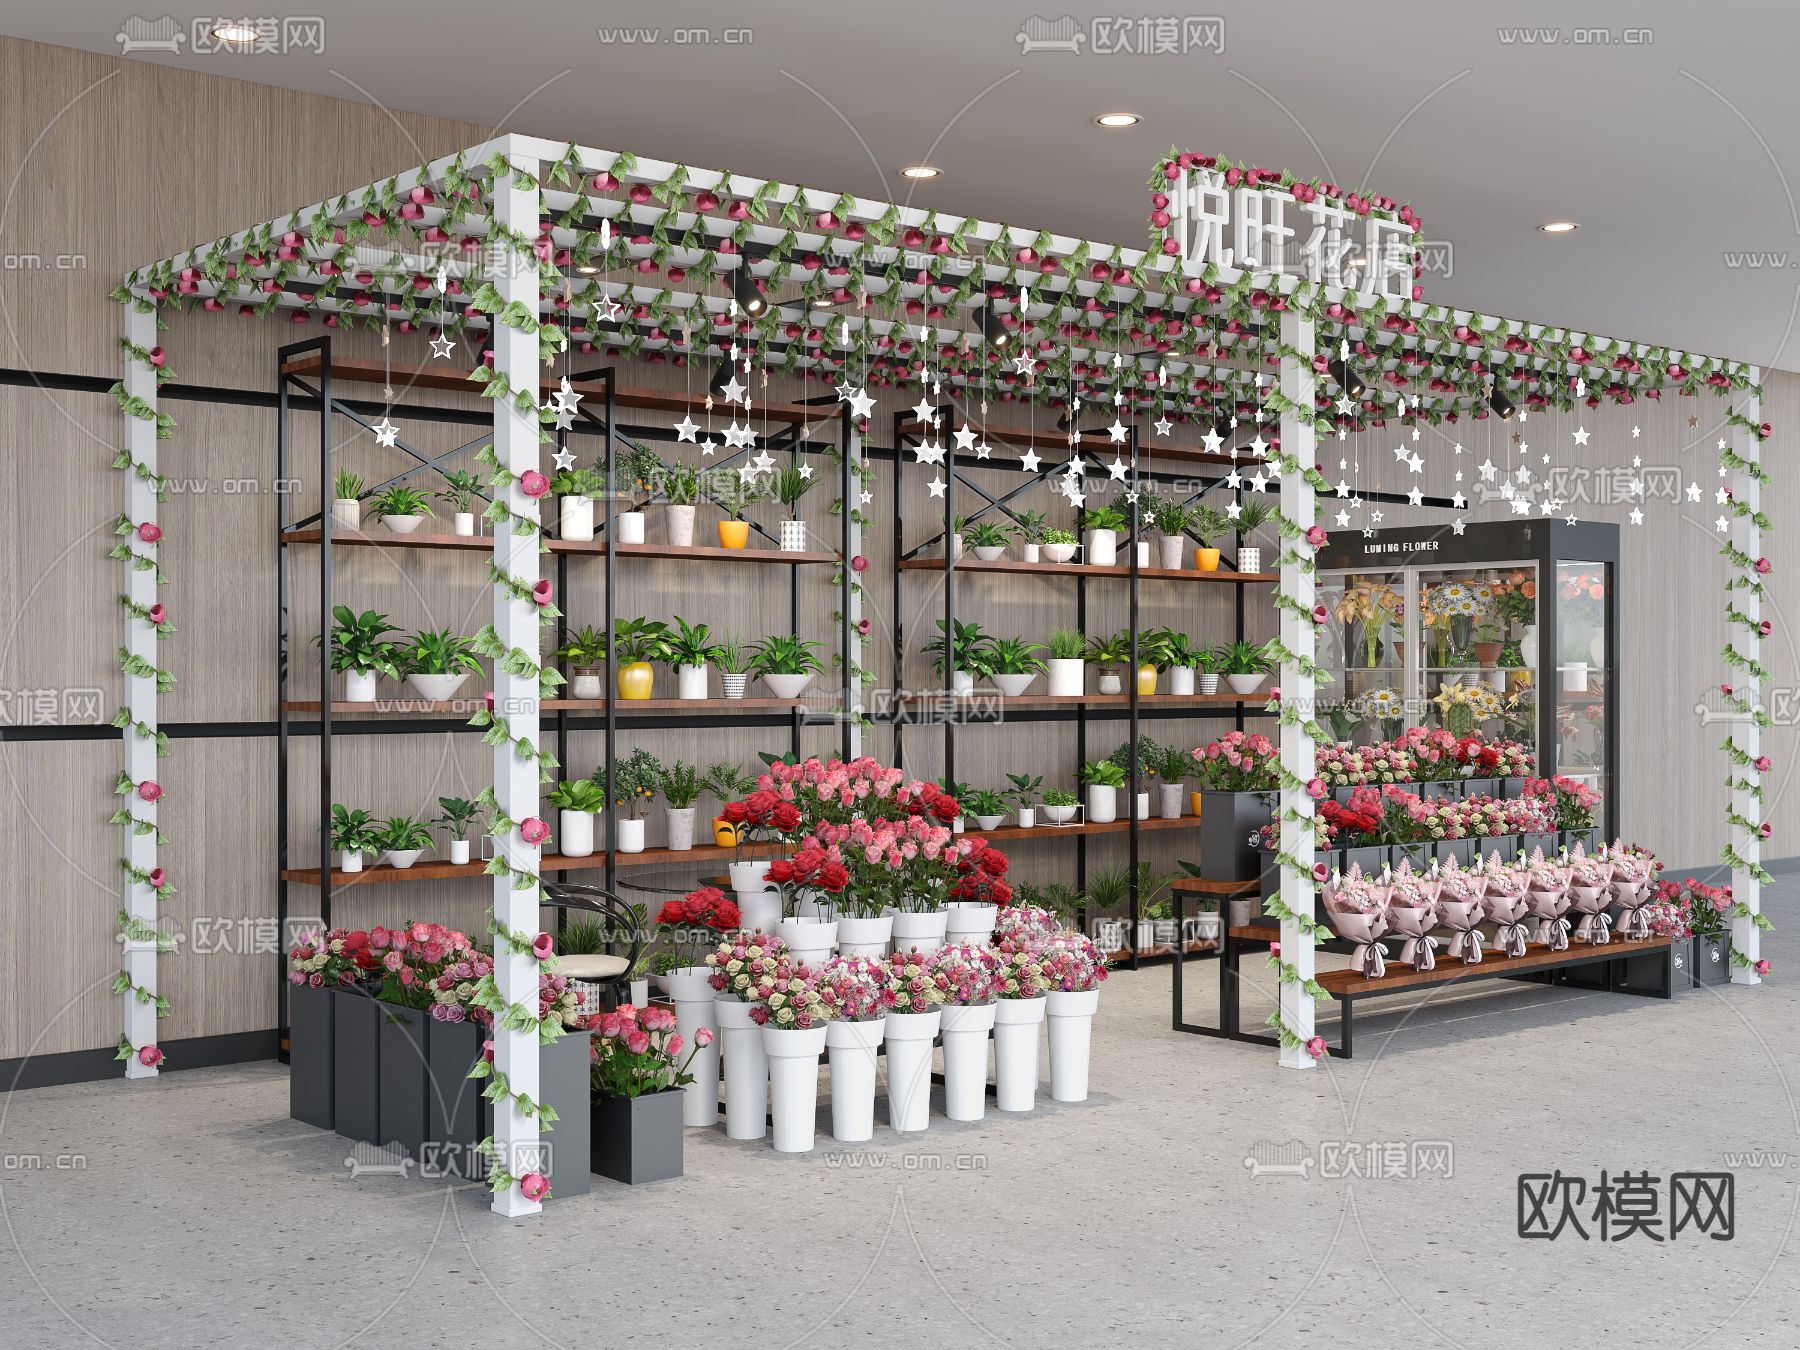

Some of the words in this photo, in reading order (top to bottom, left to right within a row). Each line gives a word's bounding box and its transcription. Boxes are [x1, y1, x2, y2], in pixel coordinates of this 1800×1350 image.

[1168, 165, 1414, 298] 悦旺花店
[1364, 543, 1399, 554] LUMING
[1402, 541, 1439, 552] FLOWER
